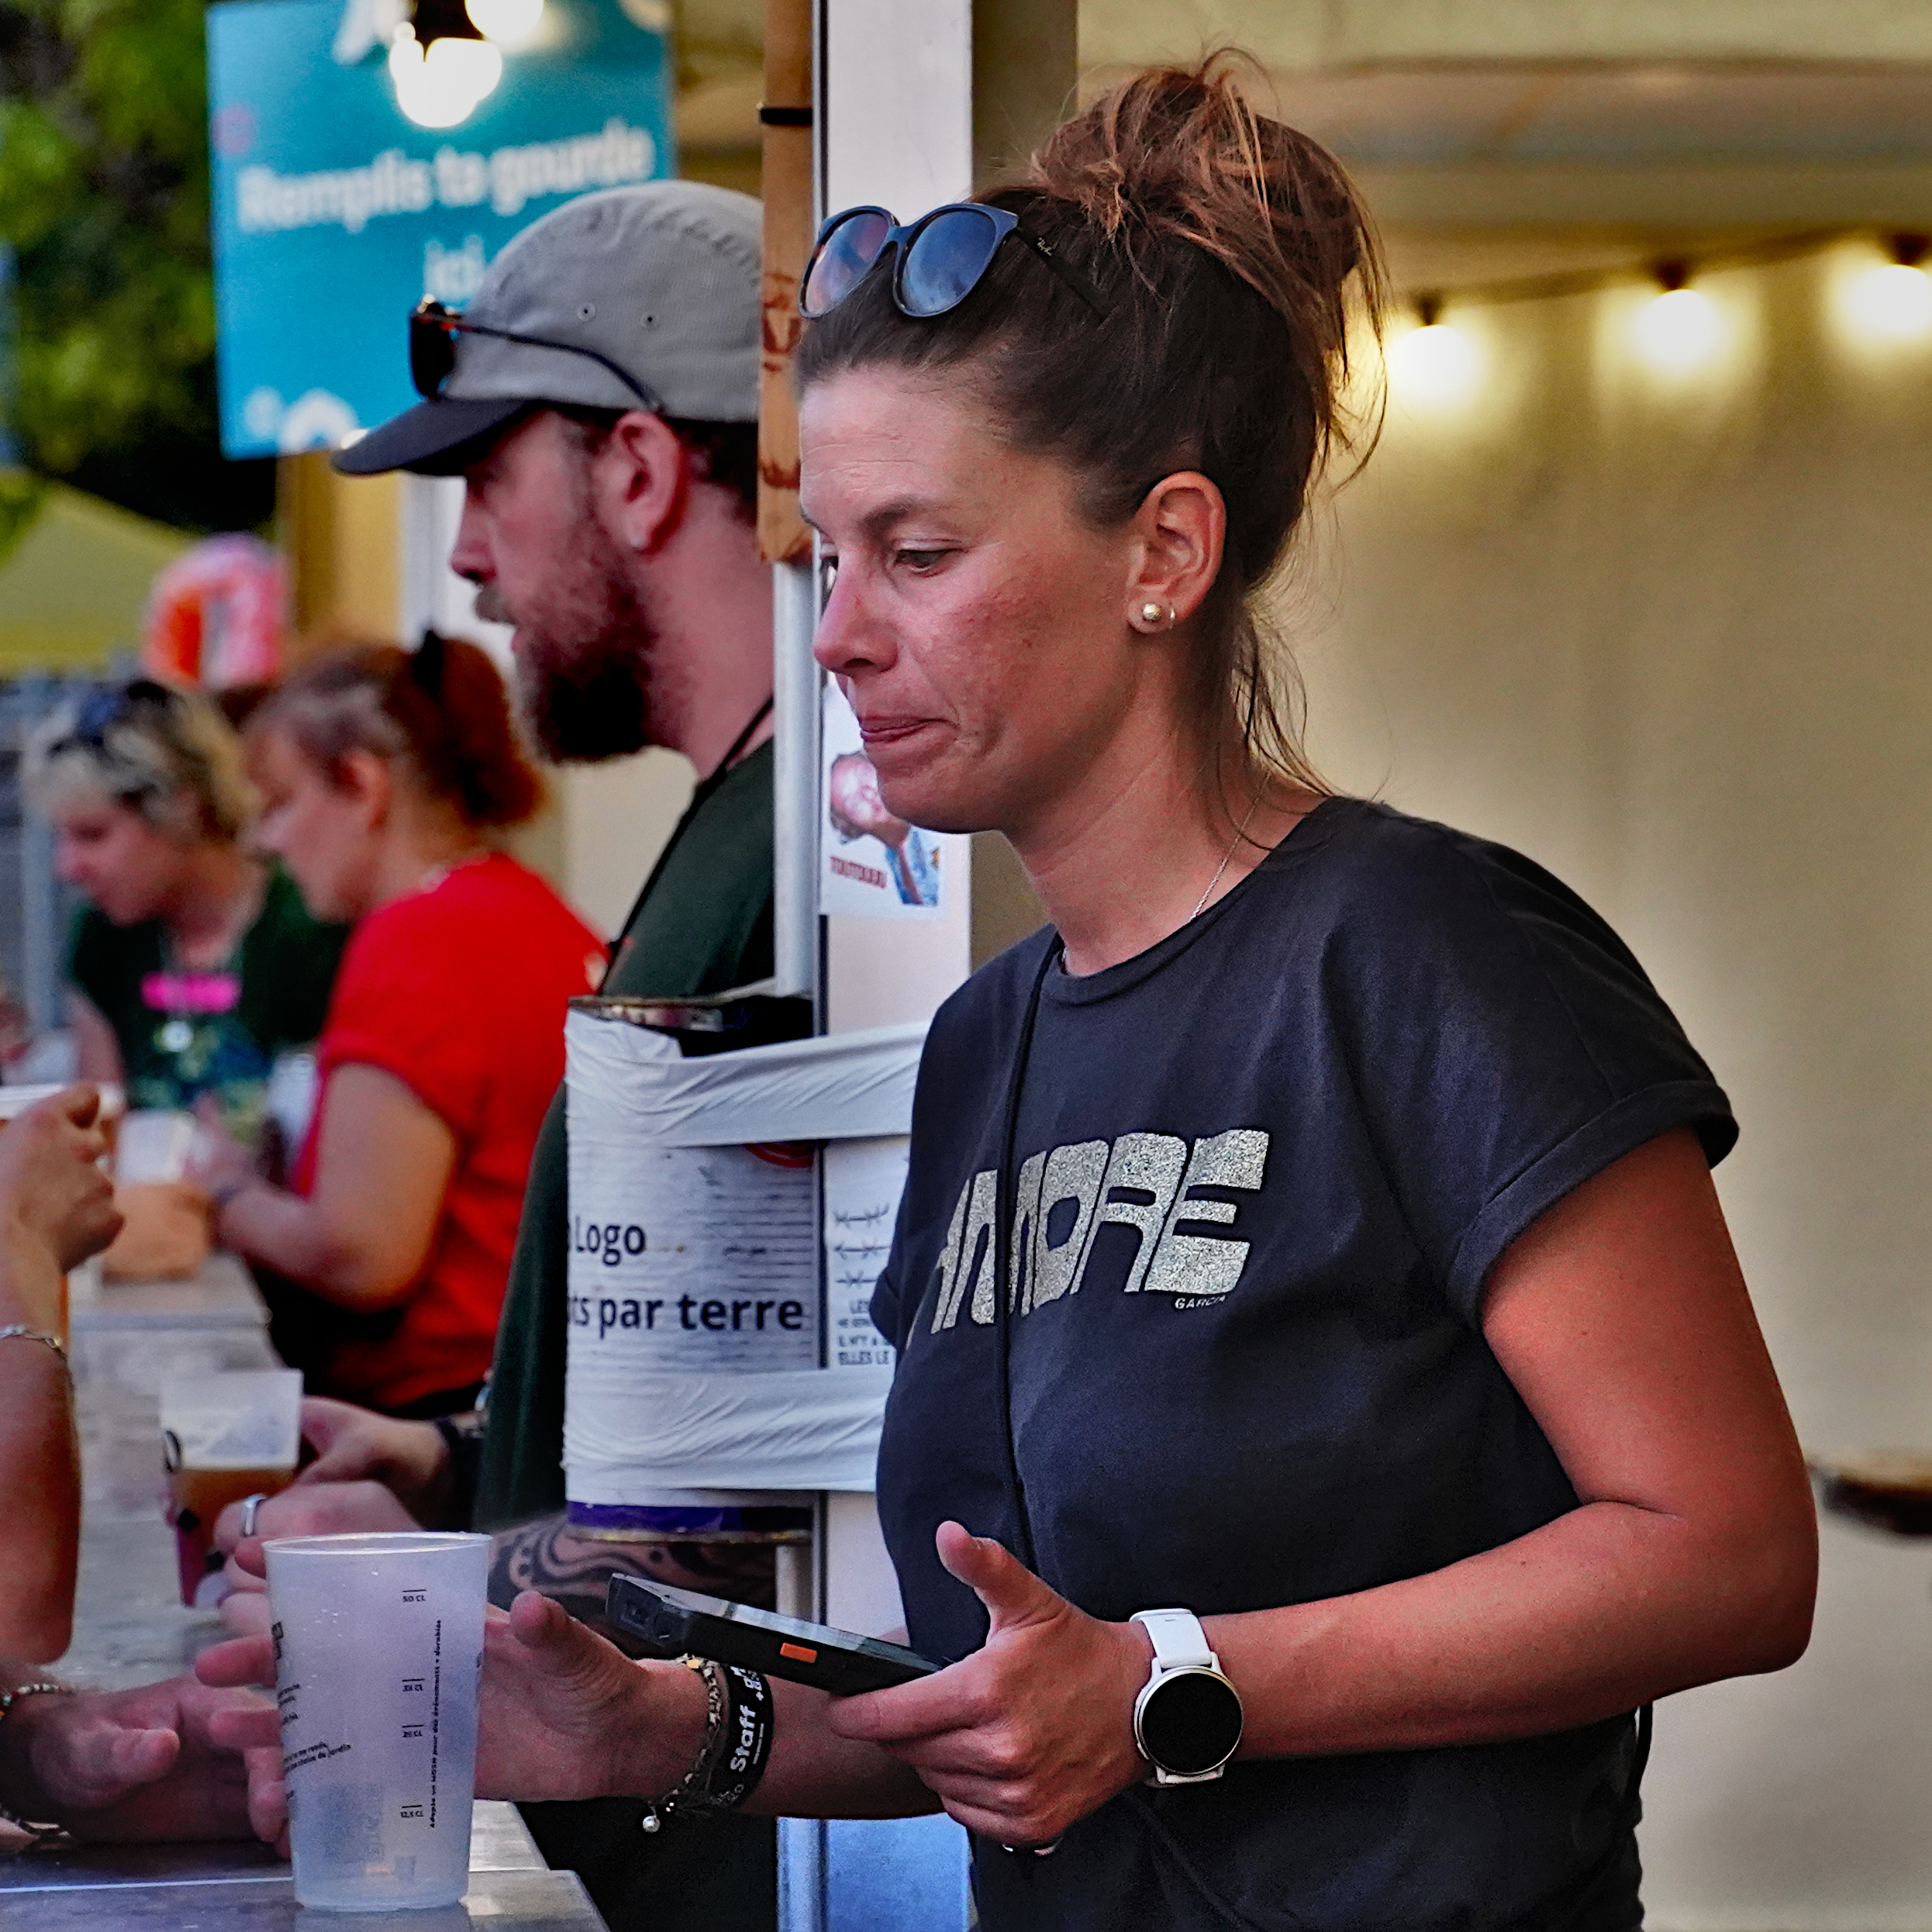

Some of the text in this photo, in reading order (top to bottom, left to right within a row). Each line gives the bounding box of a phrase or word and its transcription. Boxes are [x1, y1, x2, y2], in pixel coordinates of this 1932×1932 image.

[575, 1214, 646, 1267] Logo
[599, 1299, 663, 1340] par
[678, 1293, 802, 1331] terre
[730, 1705, 756, 1772] Staff
